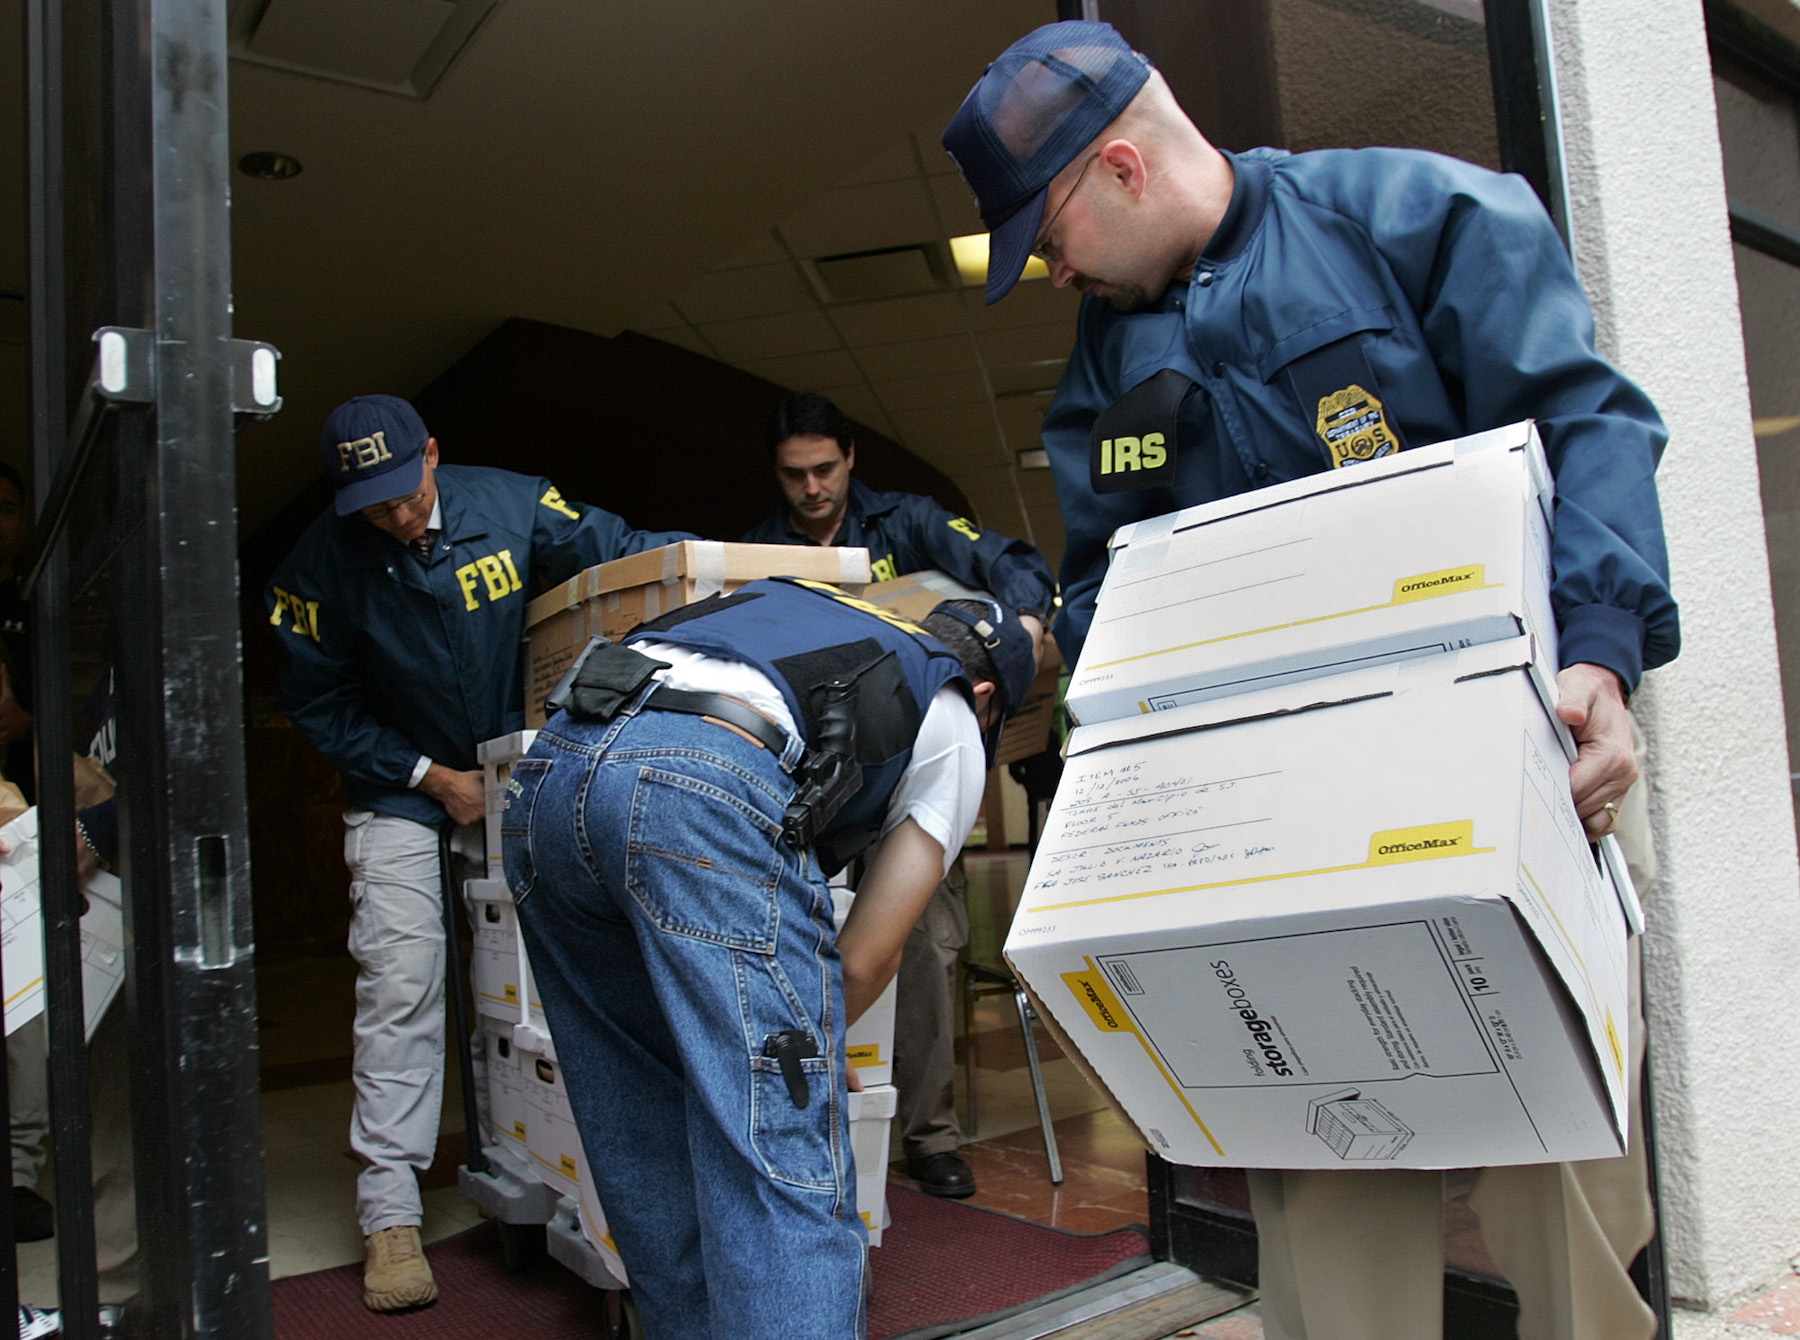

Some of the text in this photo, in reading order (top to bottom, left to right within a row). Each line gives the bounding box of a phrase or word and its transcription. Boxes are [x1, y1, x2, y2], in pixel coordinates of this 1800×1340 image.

[336, 431, 393, 472] FBI
[1101, 432, 1167, 475] IRS
[456, 549, 522, 612] FBI
[871, 553, 898, 582] BI
[1401, 573, 1473, 592] OfficeMax
[269, 586, 320, 643] FBI
[1378, 838, 1459, 855] OfficeMax
[1080, 981, 1118, 1028] OfficeMax
[1470, 977, 1490, 991] 10
